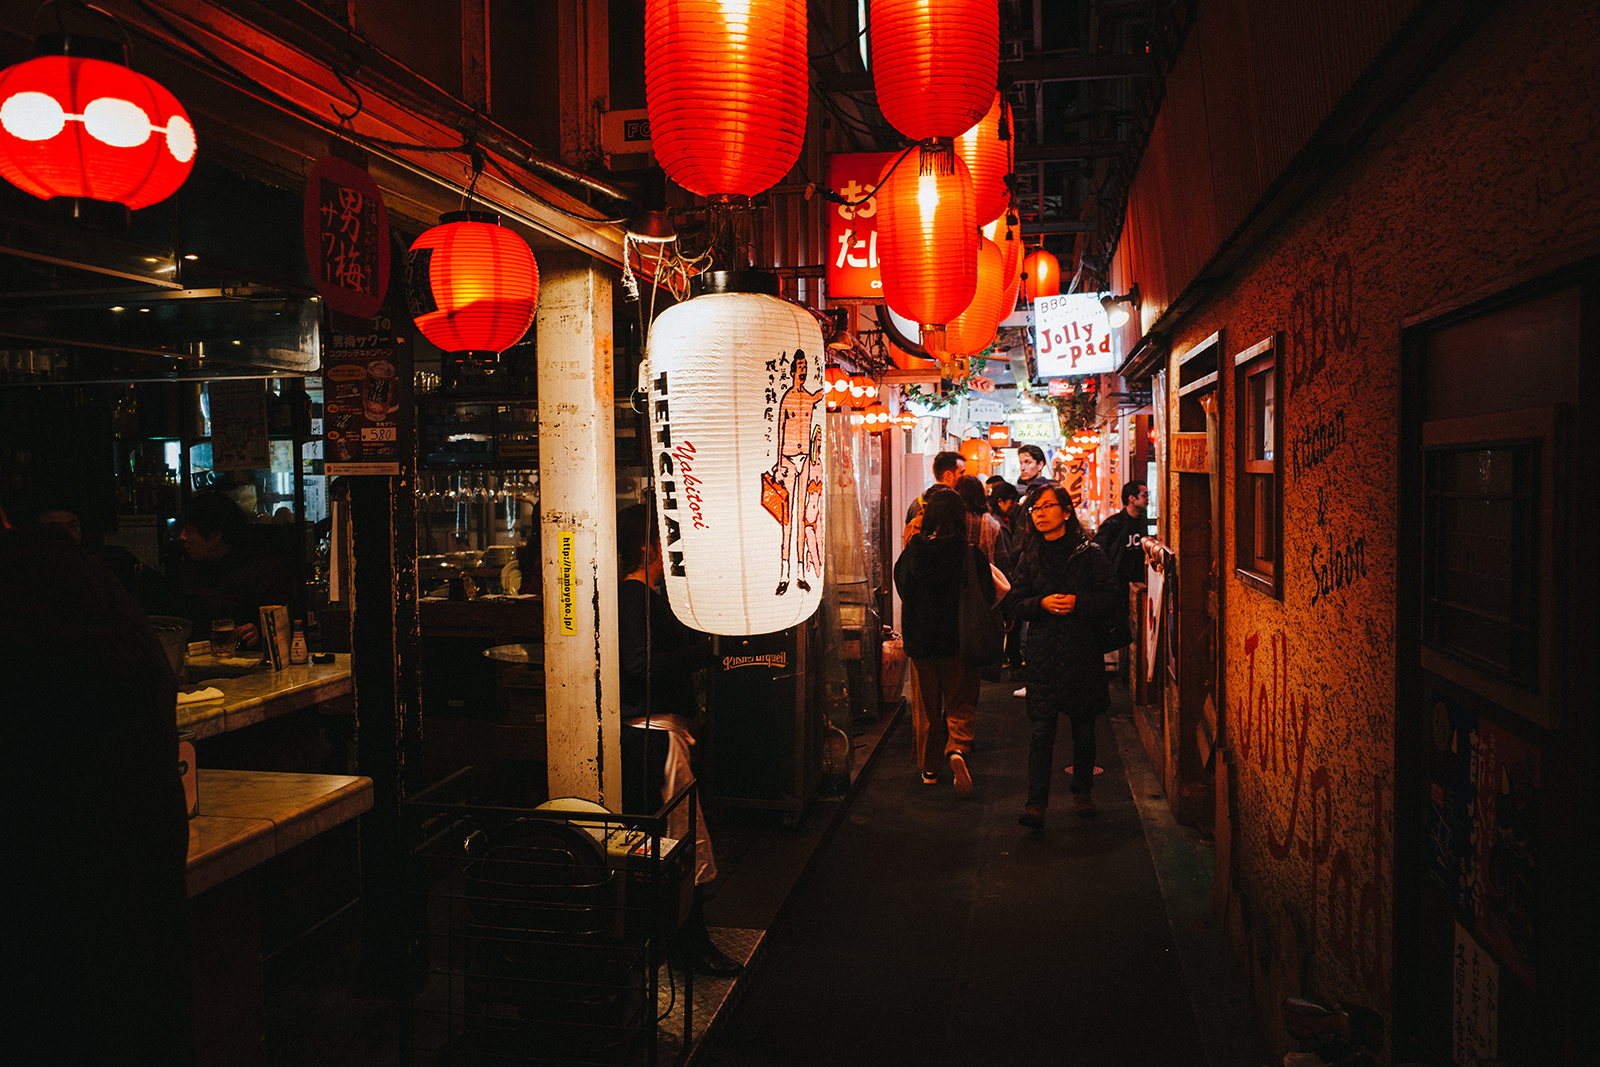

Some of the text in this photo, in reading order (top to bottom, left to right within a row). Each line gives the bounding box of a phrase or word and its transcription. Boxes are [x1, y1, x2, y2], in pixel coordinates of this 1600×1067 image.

[320, 201, 339, 284] サワー
[334, 186, 366, 294] 男梅
[332, 333, 389, 348] 男梅サワー
[1040, 296, 1067, 314] BBQ
[1041, 320, 1094, 354] Jolly
[370, 429, 392, 441] 580
[653, 371, 687, 578] TETCHAN
[1292, 405, 1346, 482] Kitchen
[672, 441, 709, 530] Yakitori
[562, 537, 573, 630] http://hamoyoko.jp/
[1311, 532, 1366, 605] Saloon
[1238, 630, 1309, 861] Jolly
